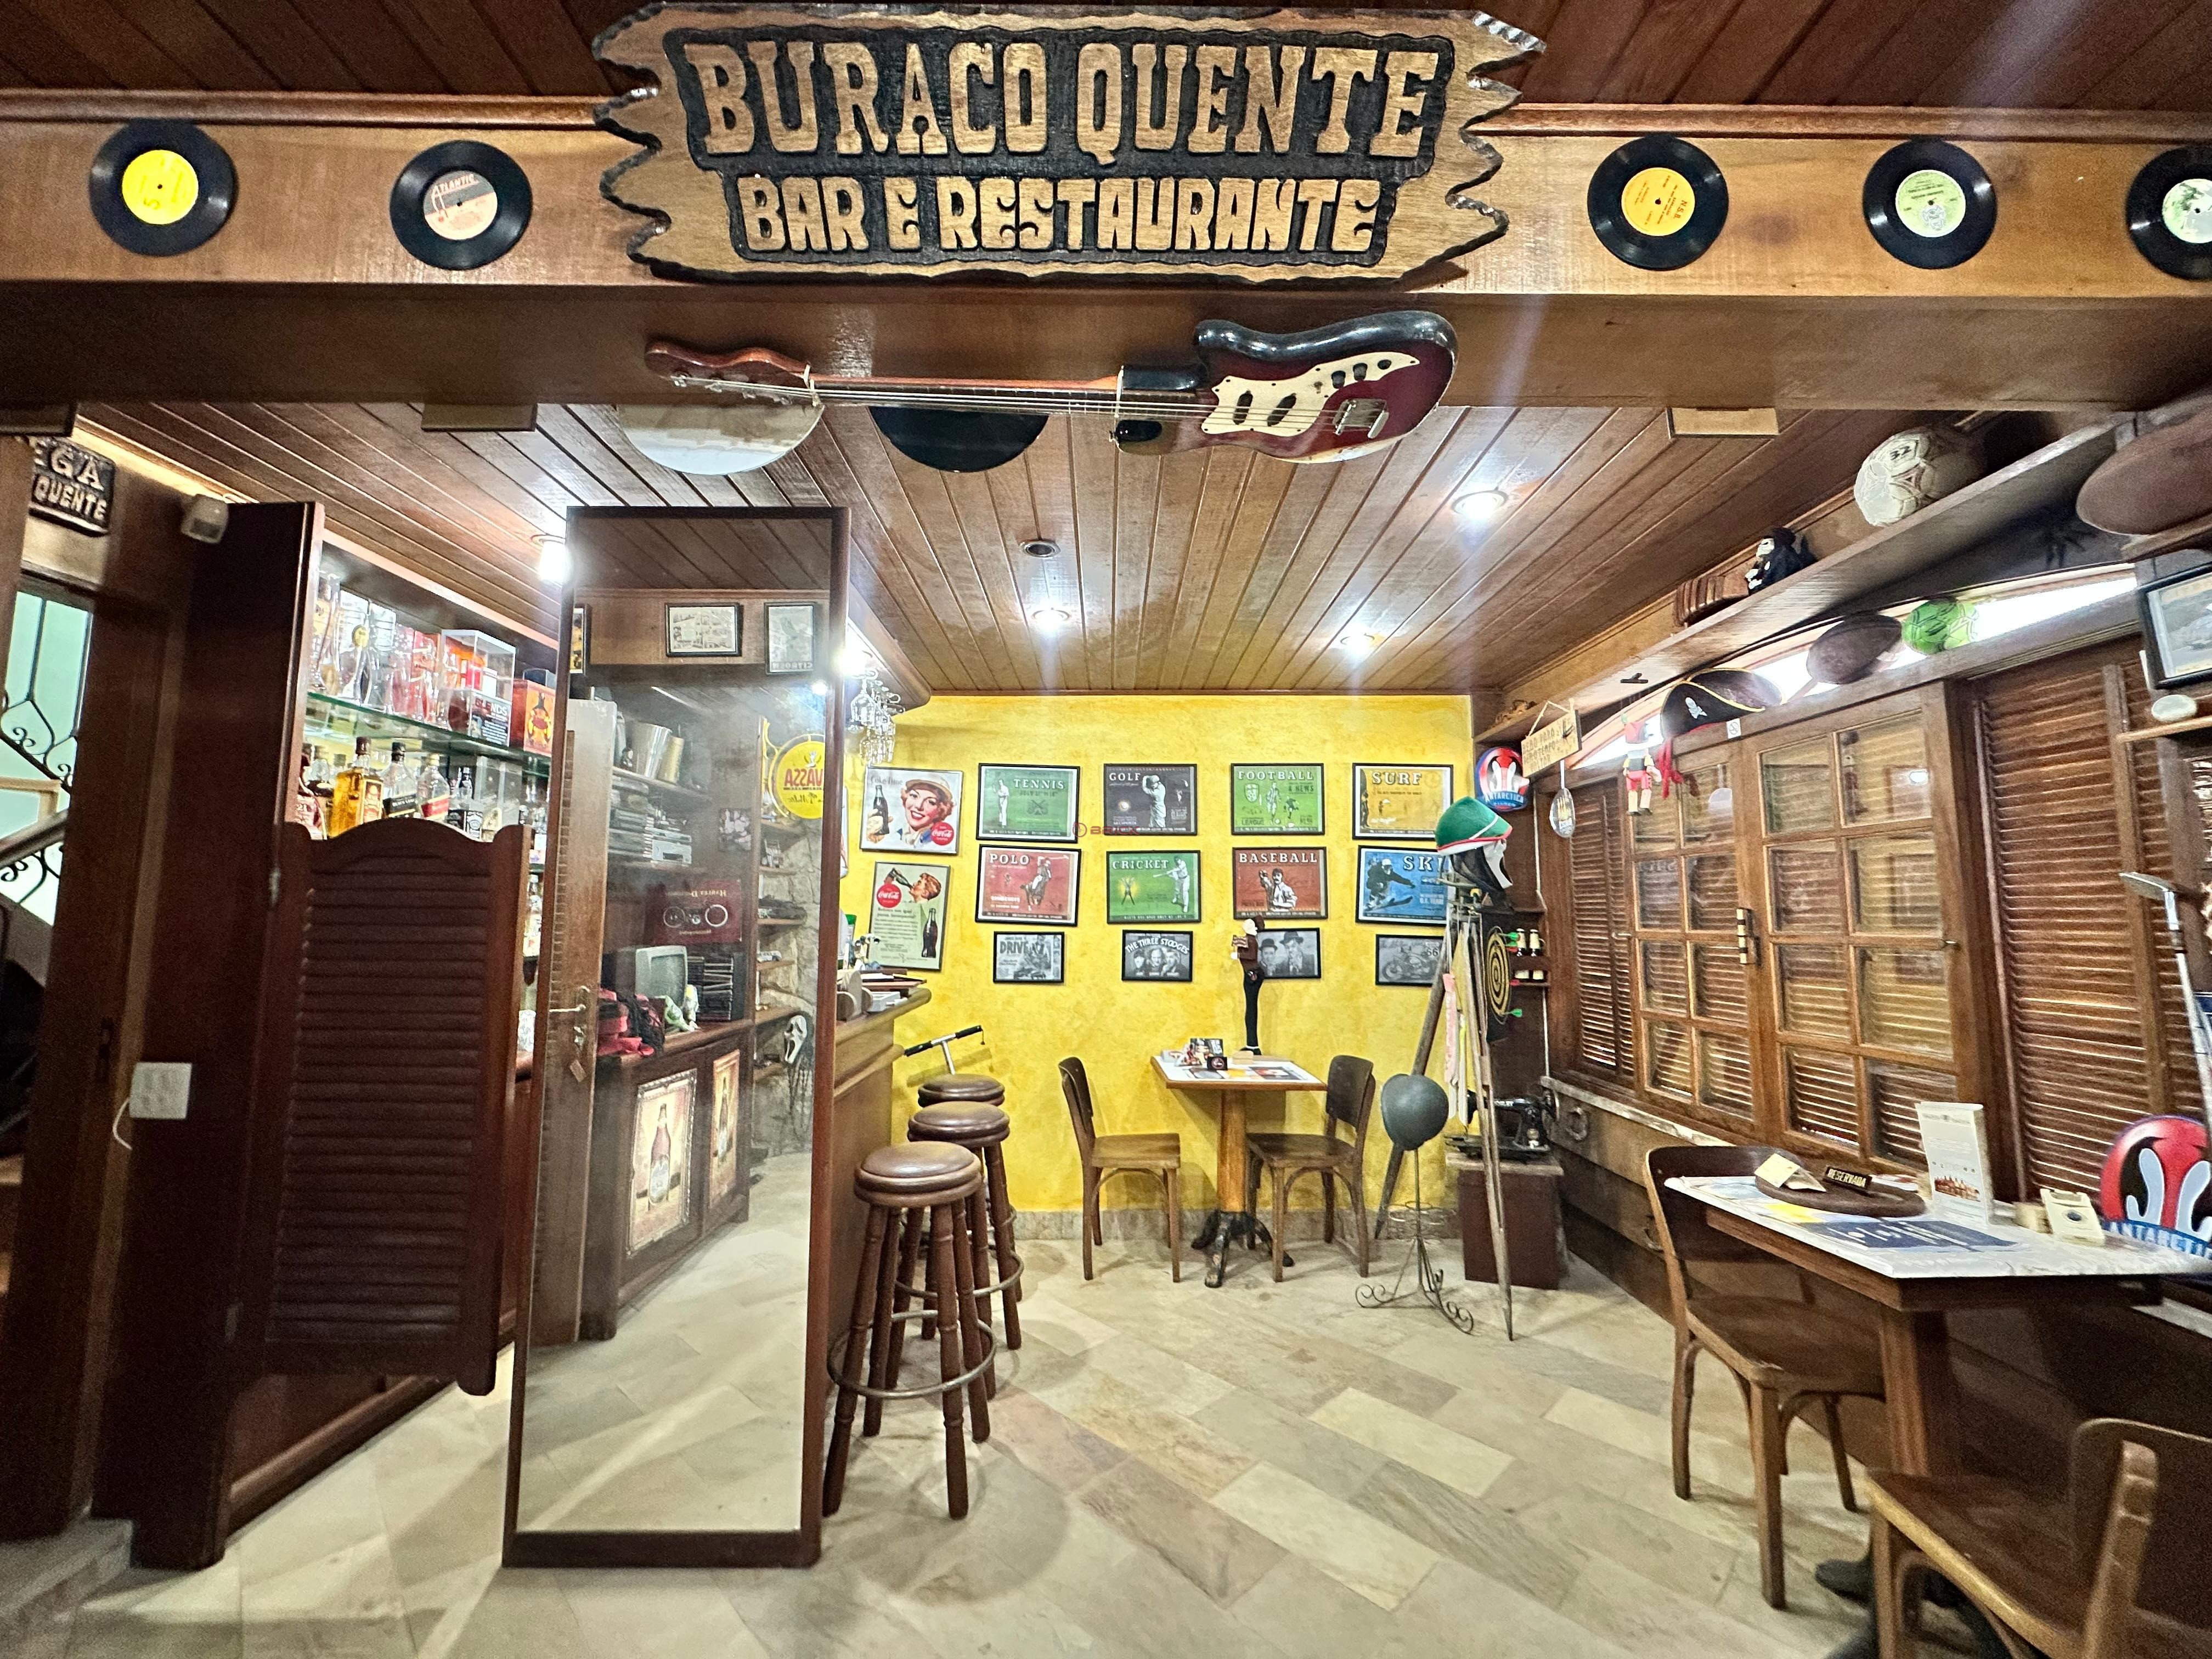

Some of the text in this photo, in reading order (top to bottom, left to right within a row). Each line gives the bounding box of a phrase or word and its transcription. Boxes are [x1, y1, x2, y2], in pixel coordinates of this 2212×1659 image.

[682, 40, 1440, 165] BURACO QUENTE
[738, 174, 1380, 254] BAR E RESTAURANTE
[1889, 446, 1911, 460] 32
[33, 475, 108, 521] QUENTE
[475, 697, 509, 716] BLENDS
[1109, 772, 1141, 781] GOLF
[1238, 771, 1314, 781] FOOTBALL
[1372, 771, 1423, 786] SURF
[1013, 778, 1065, 789] TENNIS
[1485, 792, 1524, 804] ANTARCTICA
[989, 853, 1030, 865] POLO
[1112, 860, 1169, 870] CRICKET
[1239, 853, 1317, 864] BASEBALL
[1403, 855, 1443, 872] SKI
[1125, 937, 1190, 955] THE THREE STOOGES
